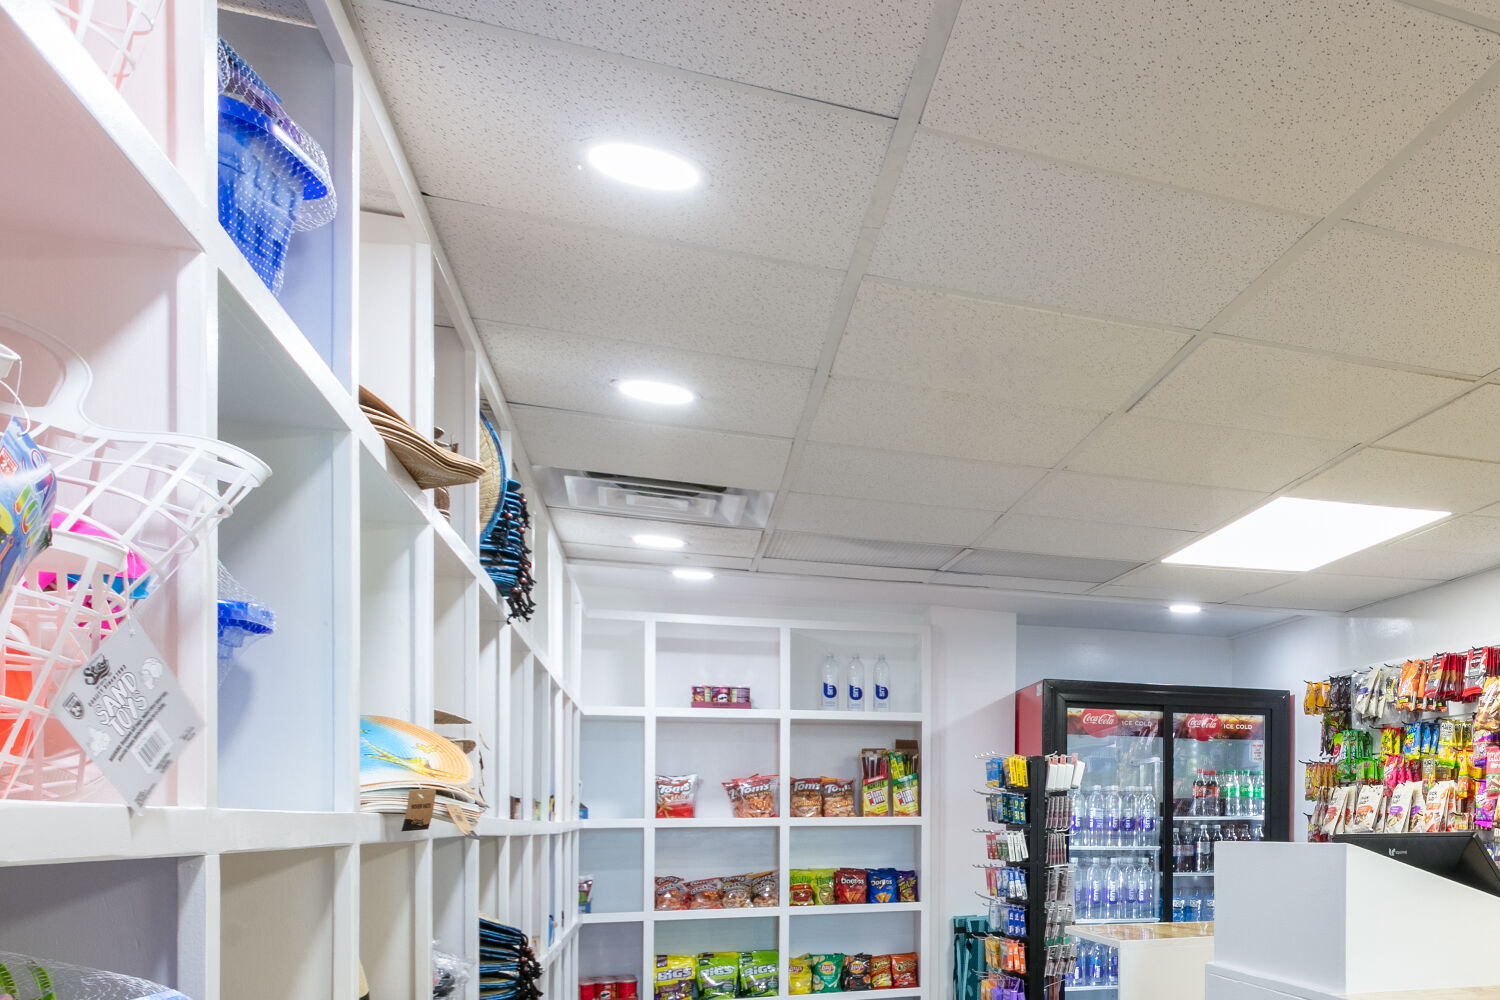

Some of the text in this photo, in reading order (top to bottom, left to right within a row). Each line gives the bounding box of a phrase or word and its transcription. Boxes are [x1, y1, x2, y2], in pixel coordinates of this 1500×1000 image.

[95, 671, 137, 726] SAND
[109, 690, 148, 737] TOYS
[1083, 713, 1115, 725] Coca-Cola
[656, 967, 693, 981] BIGS
